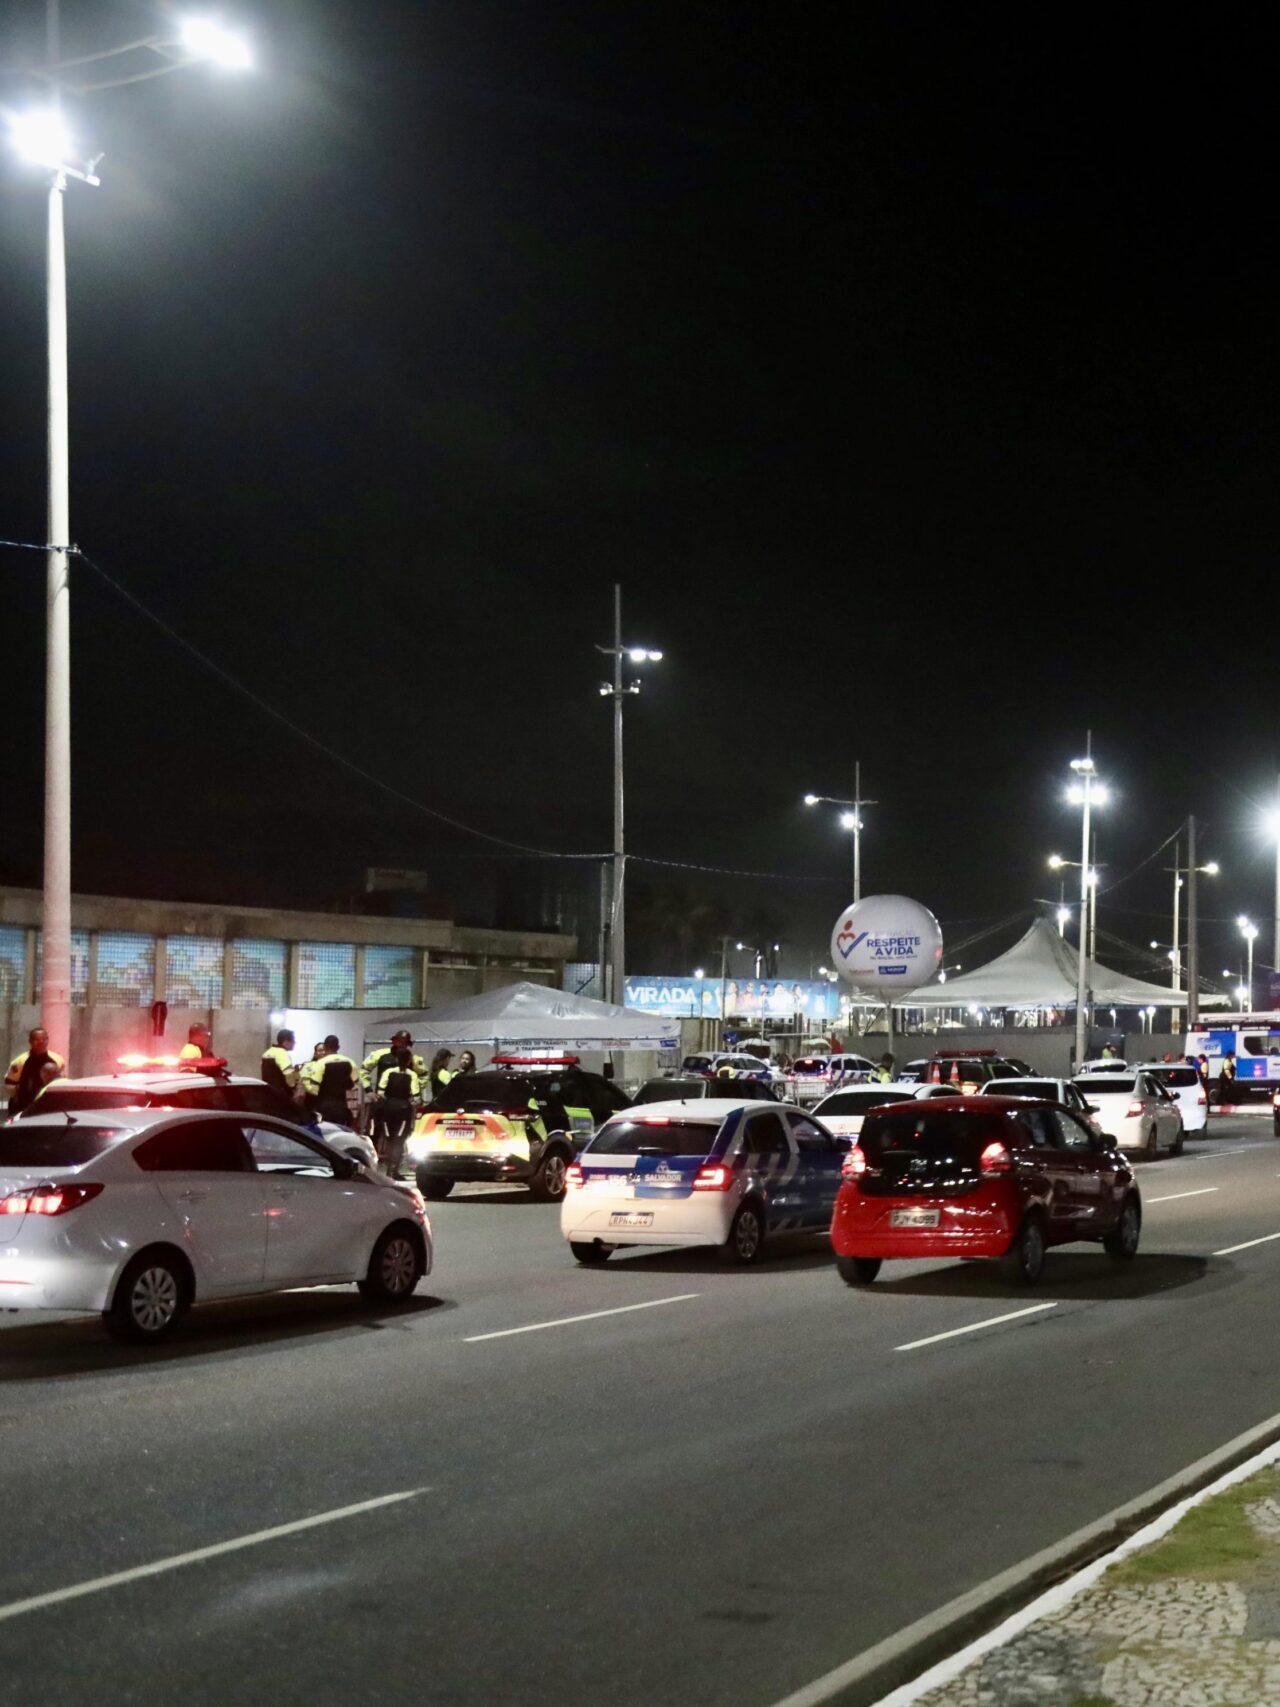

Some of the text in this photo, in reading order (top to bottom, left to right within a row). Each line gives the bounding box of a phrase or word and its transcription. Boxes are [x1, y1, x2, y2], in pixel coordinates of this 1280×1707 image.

[866, 936, 921, 948] RESPEITE
[875, 946, 914, 956] A VIDA
[626, 986, 697, 1004] VIRADA
[645, 1174, 682, 1182] SALVADOR
